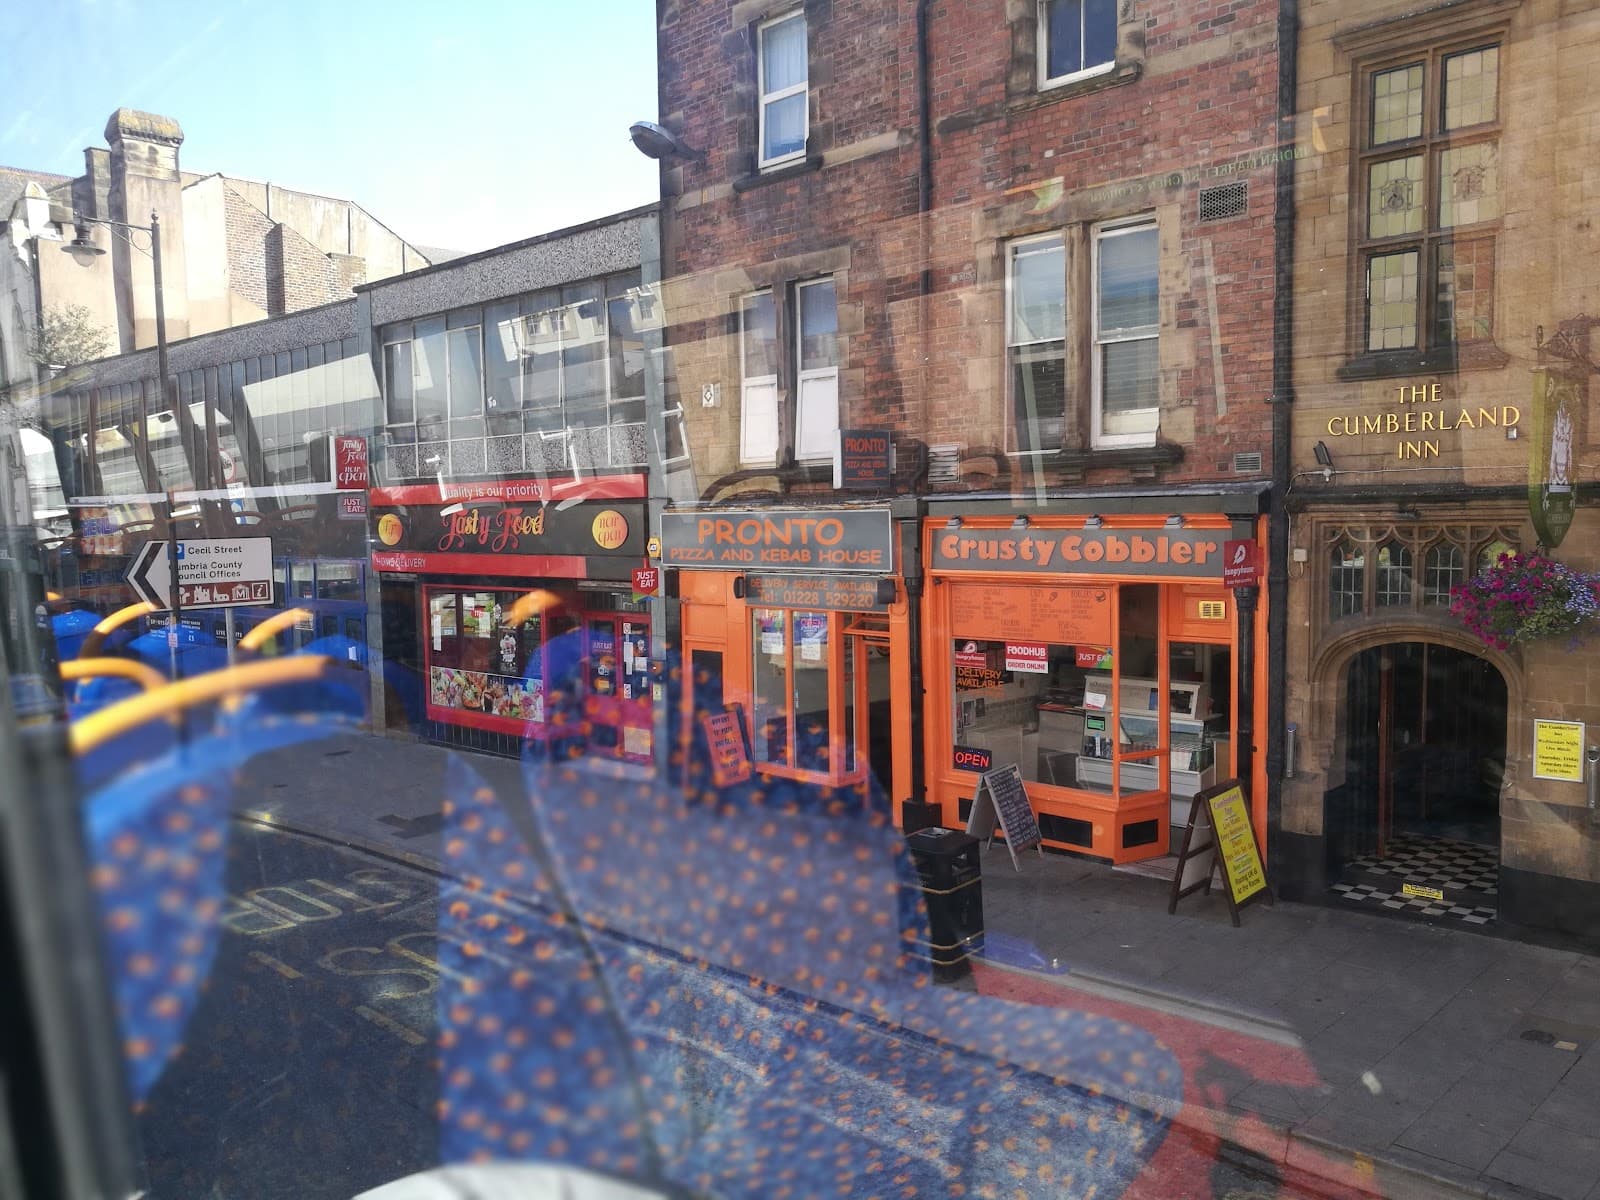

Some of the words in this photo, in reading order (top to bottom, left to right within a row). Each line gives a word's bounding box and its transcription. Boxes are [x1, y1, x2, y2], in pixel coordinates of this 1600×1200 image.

[1395, 383, 1443, 405] THE
[1327, 405, 1521, 437] CUMBERLAND
[844, 436, 887, 453] PRONTO
[1398, 439, 1440, 460] INN
[339, 472, 367, 485] open
[475, 485, 485, 497] is
[487, 487, 504, 497] our
[505, 483, 544, 499] priority
[343, 498, 361, 506] JUST
[347, 505, 361, 513] EAT
[438, 508, 490, 551] Tasty
[491, 507, 545, 552] Food
[697, 518, 844, 546] PRONTO
[188, 546, 211, 555] Cecil
[214, 545, 243, 554] Street
[670, 547, 715, 561] PIZZA
[720, 548, 754, 562] AND
[760, 549, 812, 563] KEBAB
[818, 549, 882, 564] HOUSE
[940, 534, 1056, 566] Crusty
[1060, 534, 1218, 564] Cobbler
[210, 560, 243, 571] County
[178, 571, 207, 580] ouncil
[209, 570, 241, 579] Offices
[636, 571, 656, 580] JUST
[640, 579, 655, 588] EAT
[792, 579, 829, 591] SERVICE
[783, 590, 819, 605] 01228
[825, 591, 875, 608] 529220
[1007, 645, 1047, 657] FOODHUB
[1079, 653, 1095, 661] JUST
[1096, 653, 1110, 662] EAT
[1026, 662, 1046, 670] ONLINE
[959, 667, 1002, 679] DELIVERY
[956, 678, 1003, 689] AVAILABLE
[955, 751, 990, 768] OPEN
